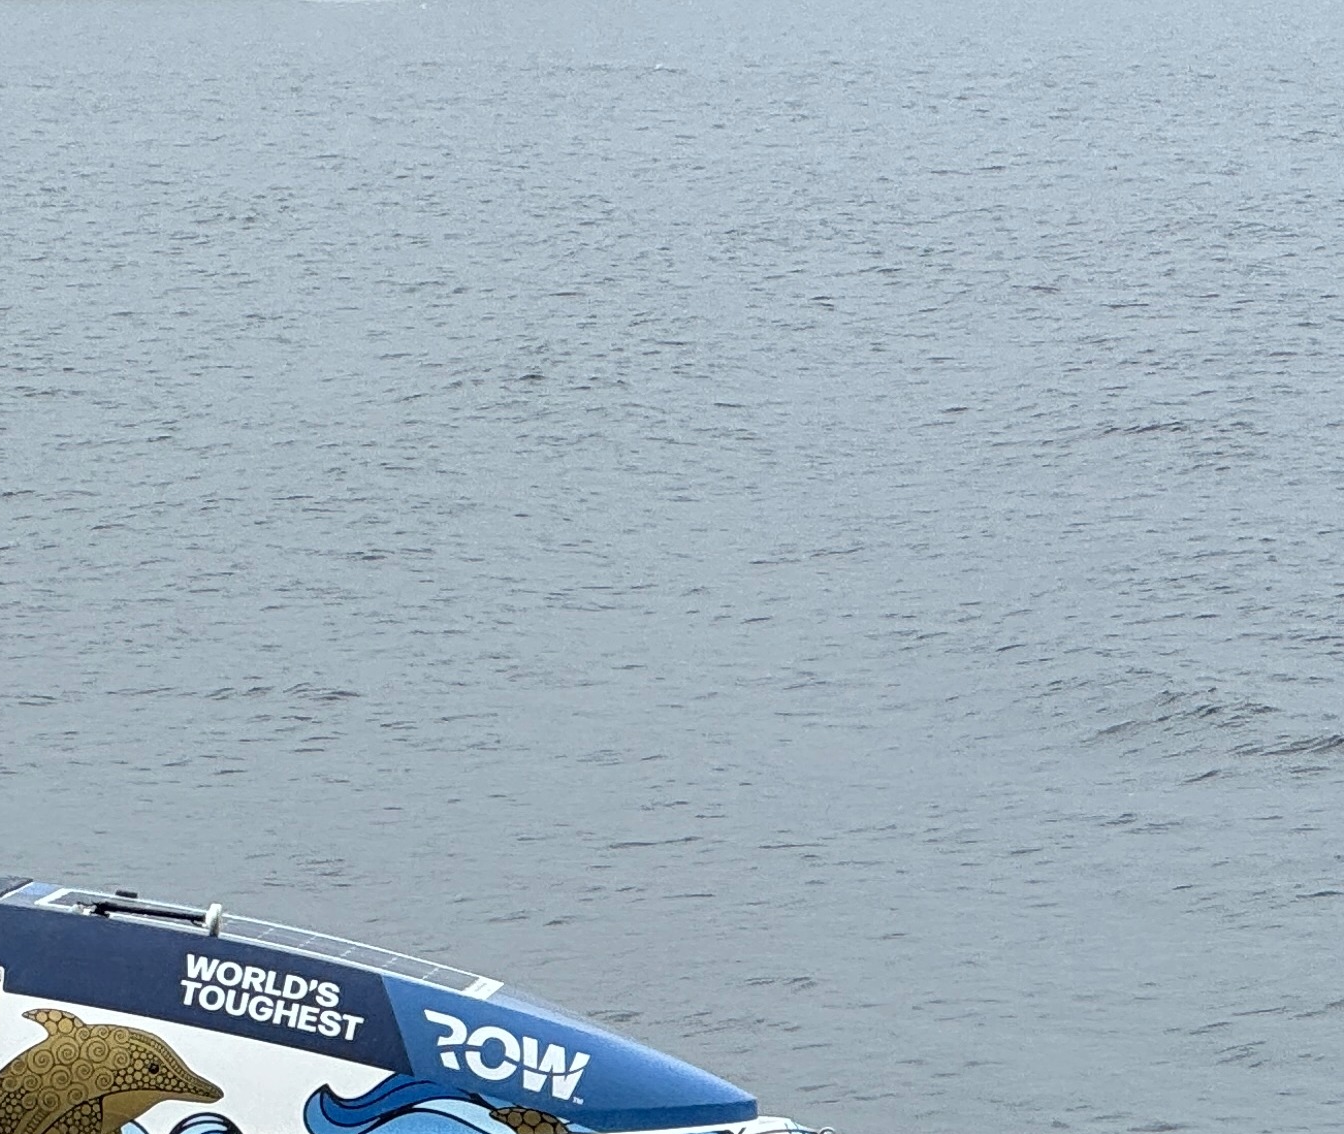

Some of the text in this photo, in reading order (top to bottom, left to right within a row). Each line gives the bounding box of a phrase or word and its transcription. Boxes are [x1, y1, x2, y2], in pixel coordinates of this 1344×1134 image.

[180, 979, 365, 1041] TOUGHEST
[186, 953, 340, 1008] WORLD'S
[423, 1008, 591, 1101] ROW
